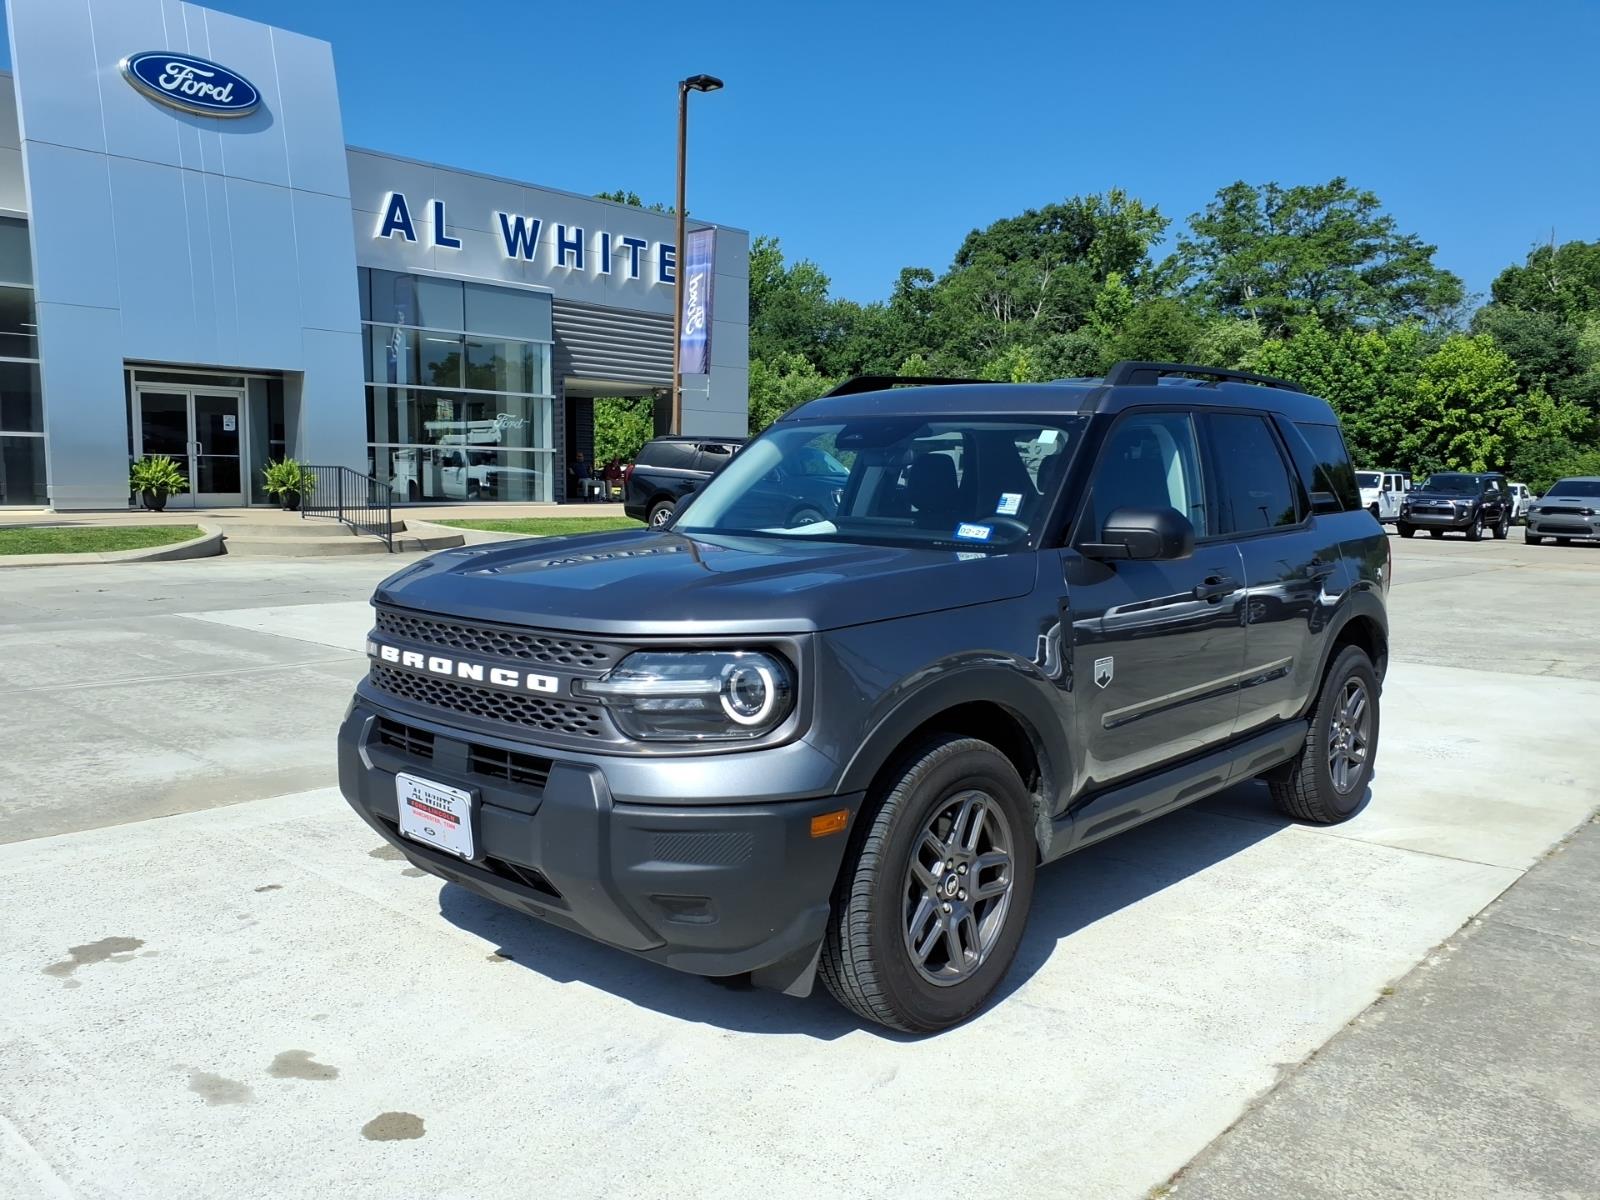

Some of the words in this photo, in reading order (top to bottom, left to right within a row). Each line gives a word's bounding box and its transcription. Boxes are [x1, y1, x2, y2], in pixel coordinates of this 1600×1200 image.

[158, 62, 233, 103] Ford
[376, 192, 462, 250] AL
[496, 211, 676, 285] WHITE
[494, 413, 524, 429] Ford
[381, 644, 559, 693] BRONCO
[411, 788, 423, 801] AL
[424, 791, 452, 812] WHITE
